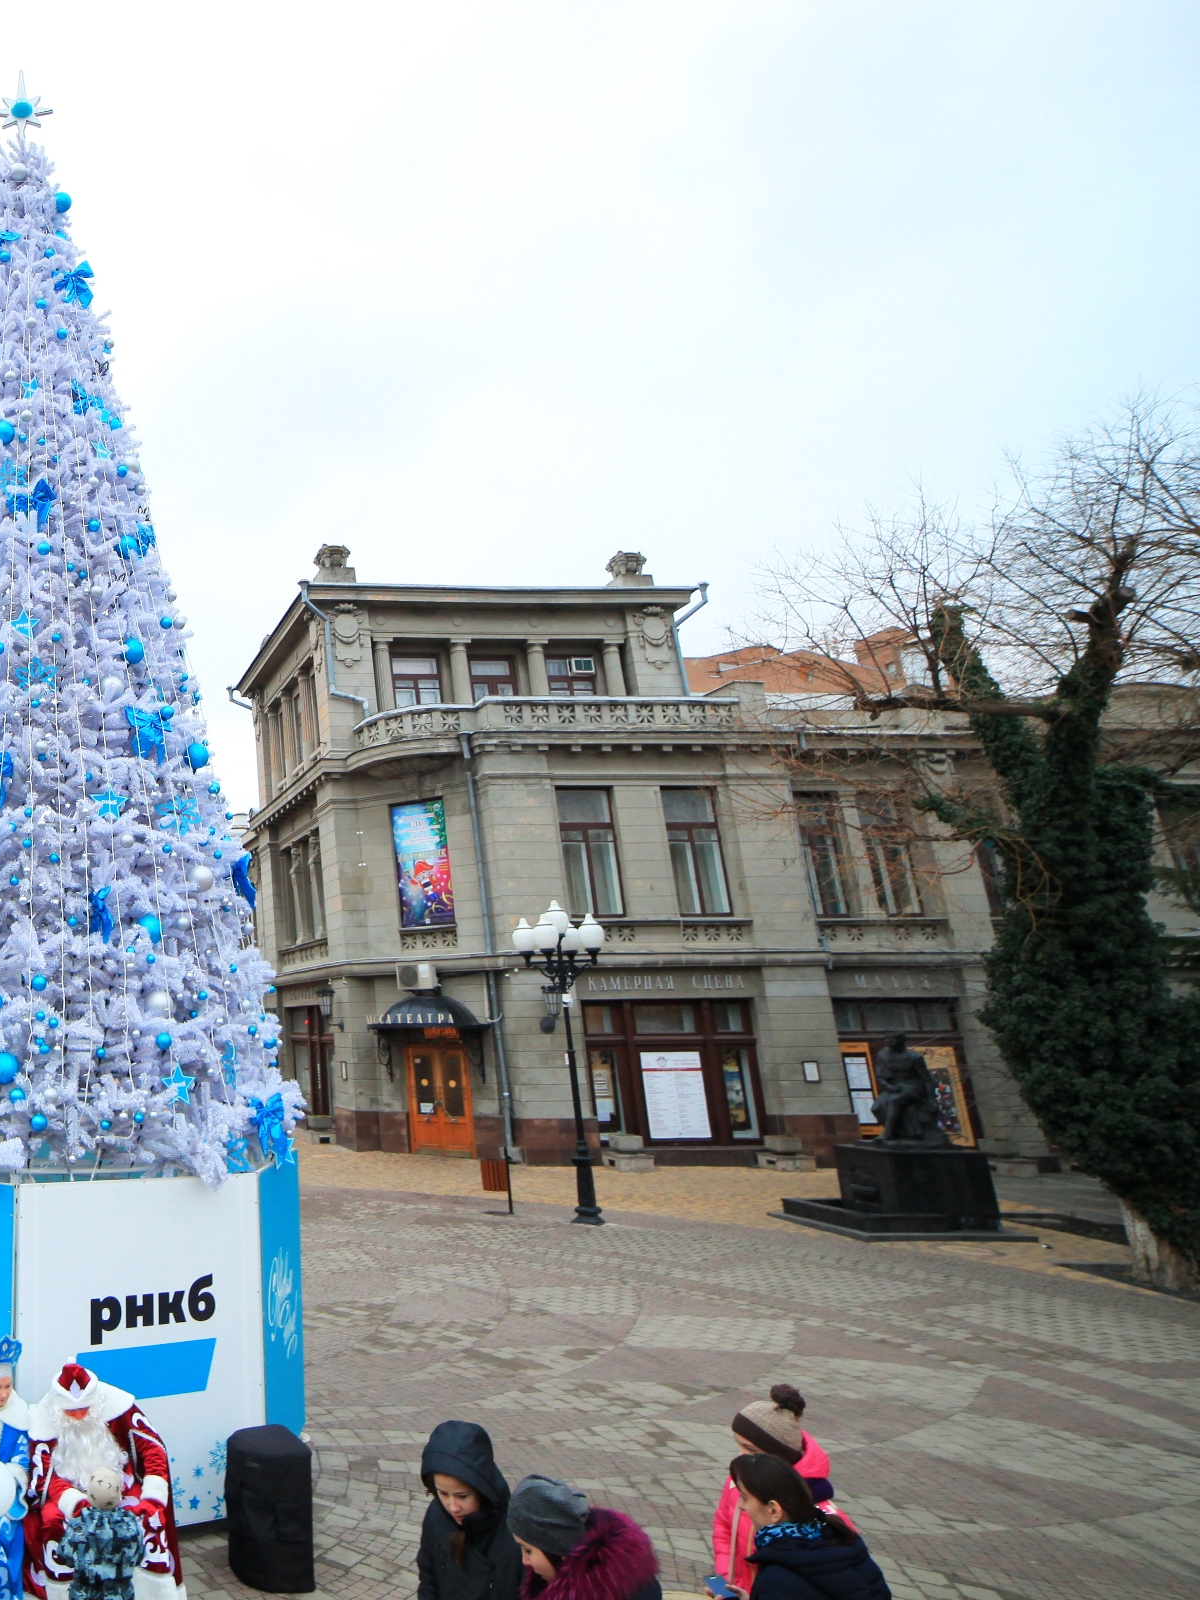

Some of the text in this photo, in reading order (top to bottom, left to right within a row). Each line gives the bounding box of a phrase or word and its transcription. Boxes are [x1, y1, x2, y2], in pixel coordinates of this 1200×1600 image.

[587, 974, 745, 991] КАМЕРНАЯ СЦЕНА
[396, 1013, 454, 1024] ТЕАТРА
[89, 1272, 217, 1346] рнкб
